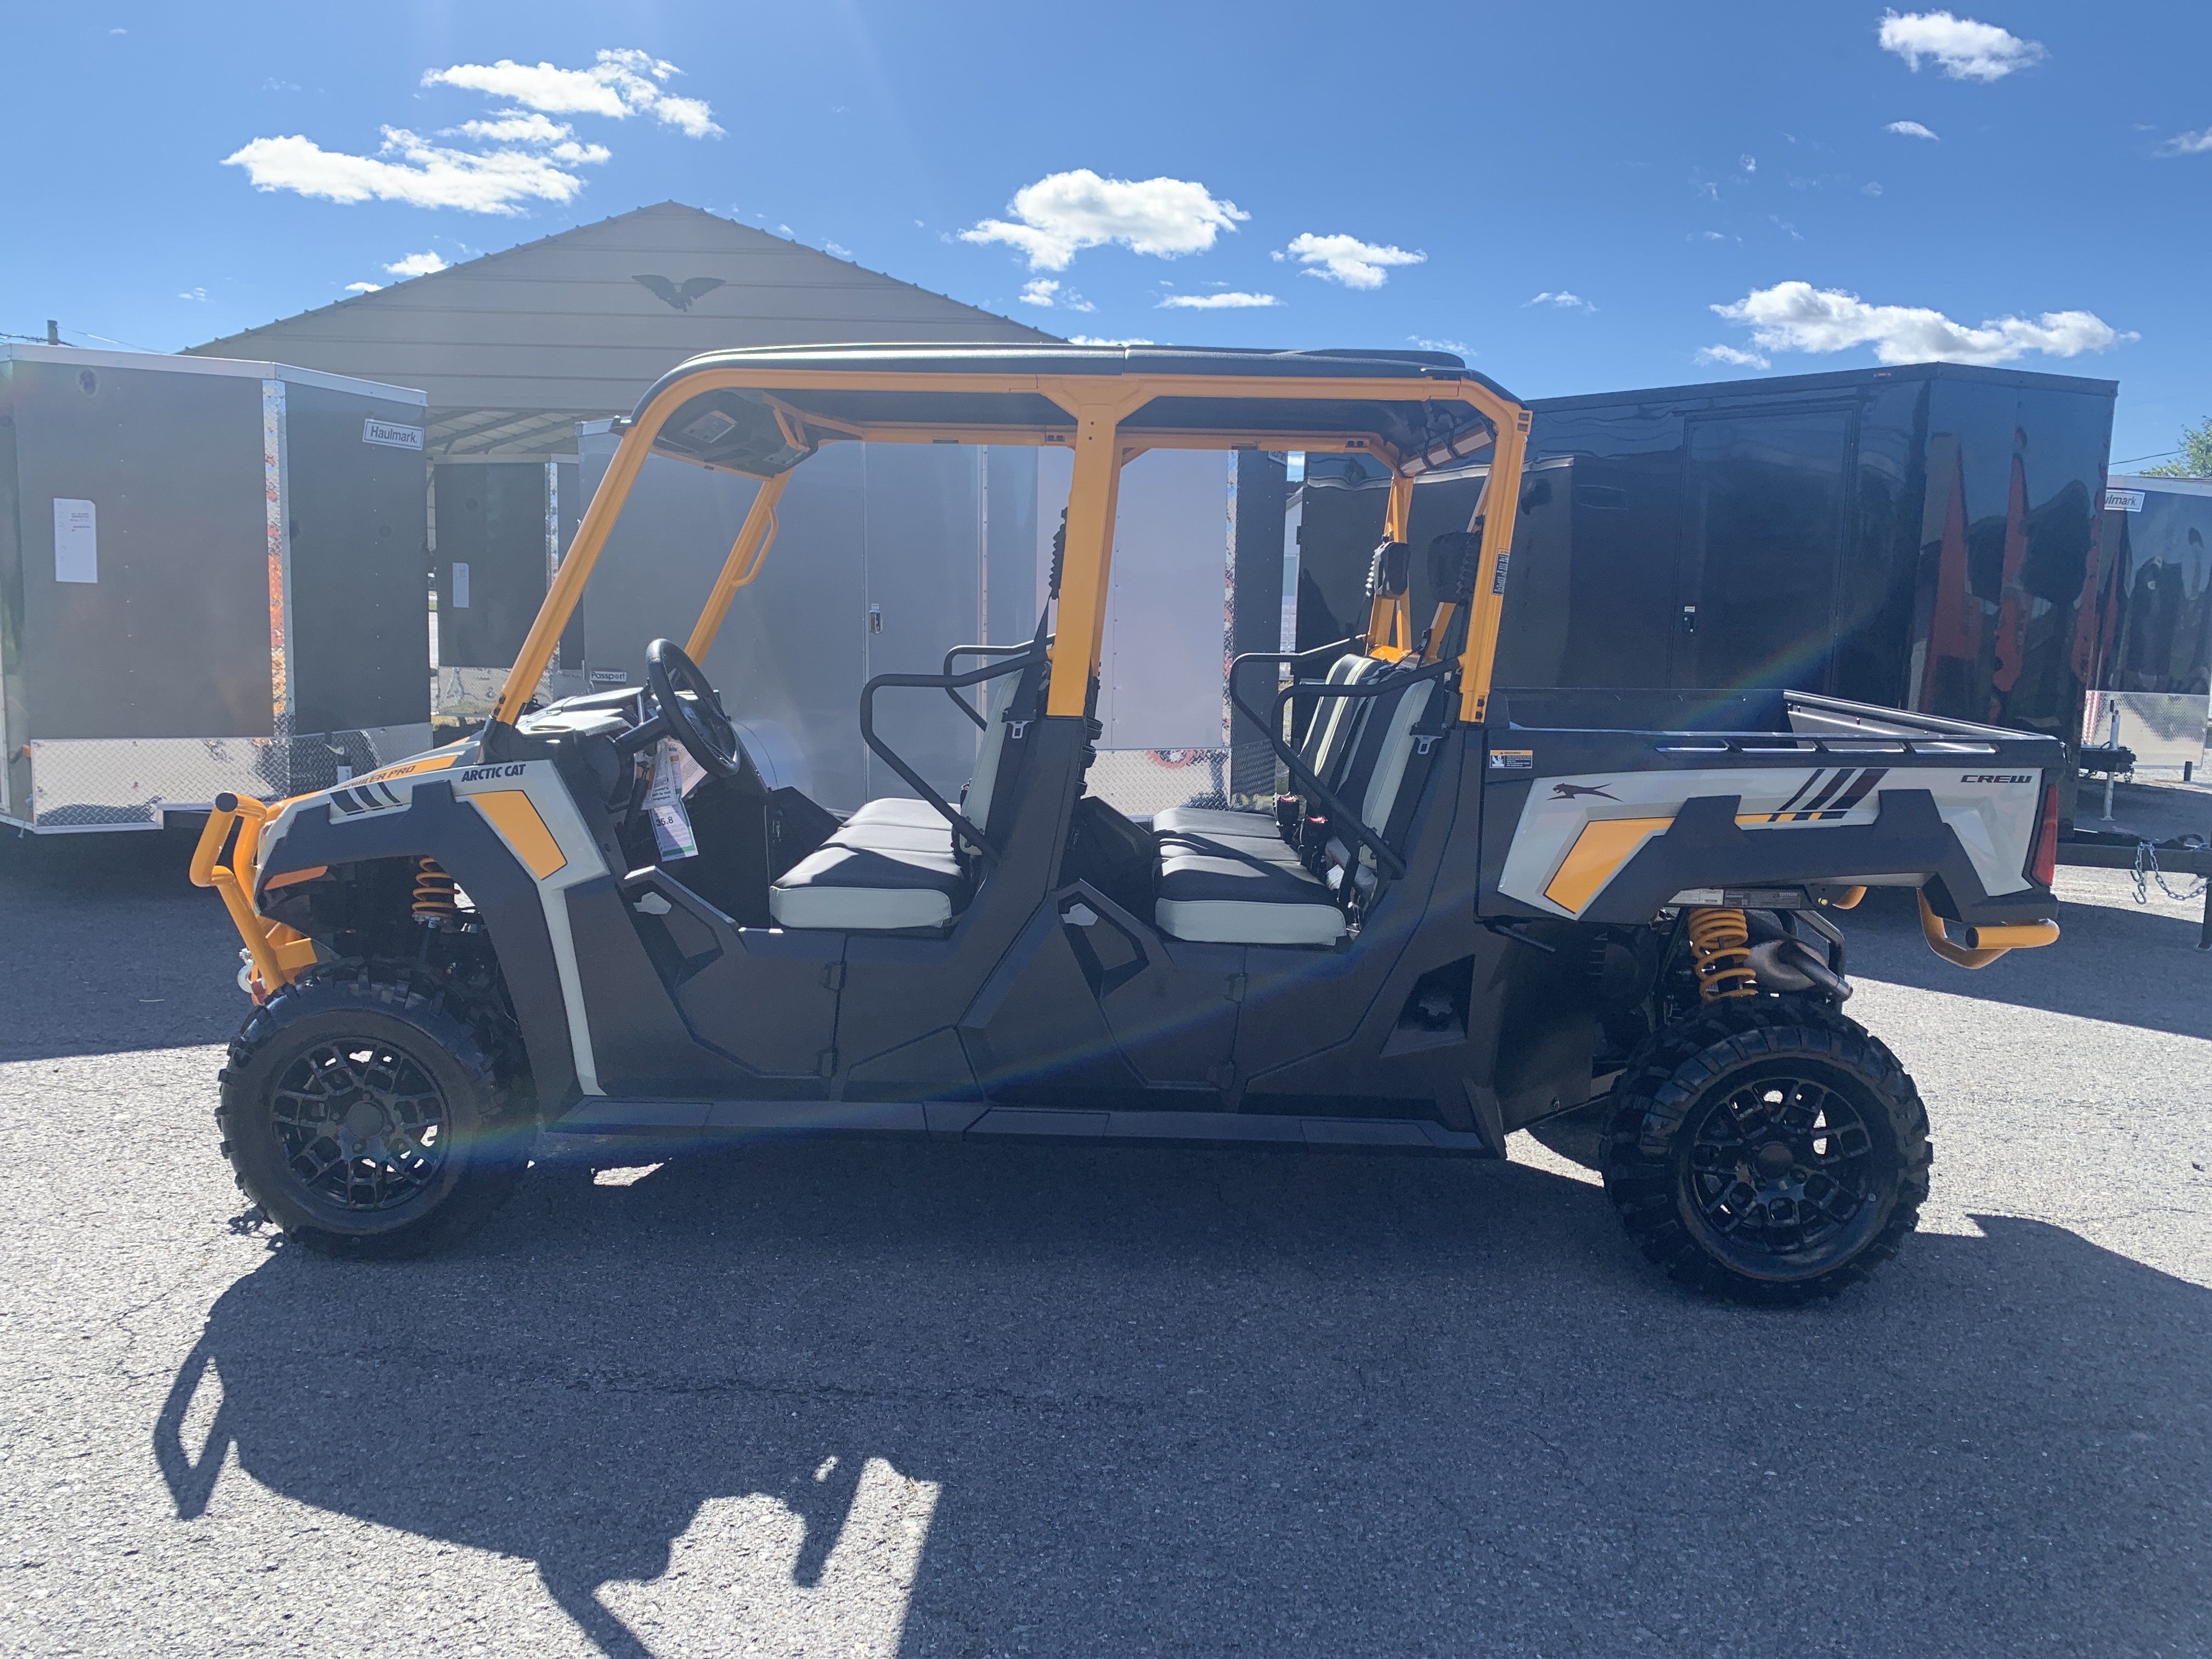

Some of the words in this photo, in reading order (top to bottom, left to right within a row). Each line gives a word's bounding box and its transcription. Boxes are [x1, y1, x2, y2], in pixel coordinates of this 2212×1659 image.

[370, 426, 416, 443] Haulmark
[2105, 495, 2136, 506] ulmark
[591, 672, 625, 681] Passport
[387, 765, 417, 778] PRO
[461, 766, 503, 782] ARCTIC
[505, 764, 526, 777] CAT
[1961, 775, 2033, 783] CREW
[656, 816, 674, 827] 35.8
